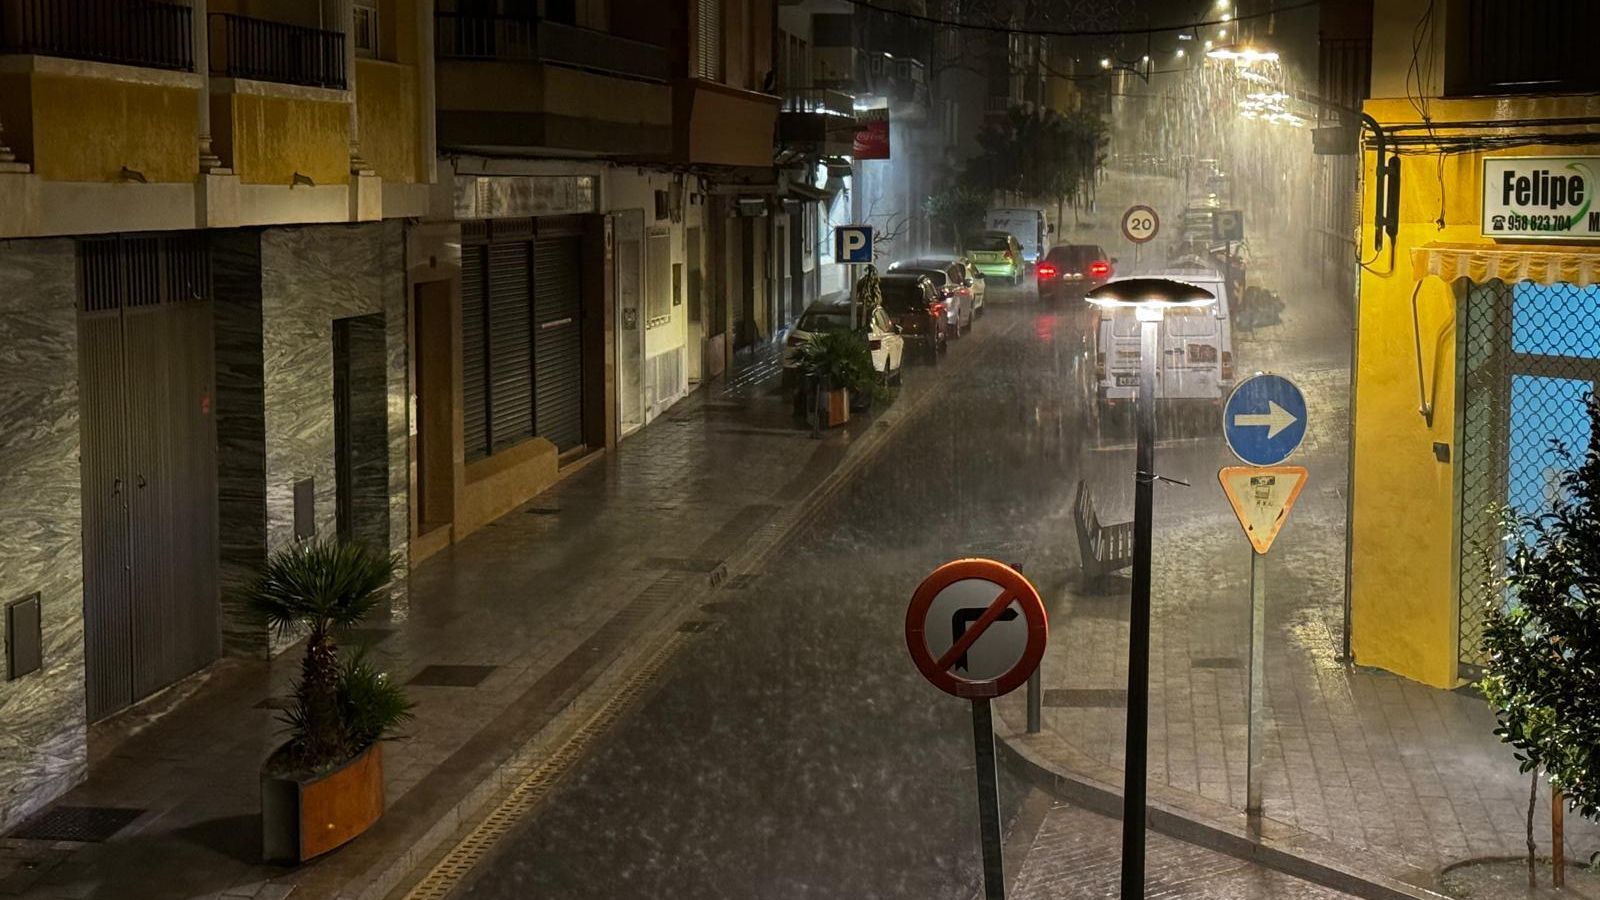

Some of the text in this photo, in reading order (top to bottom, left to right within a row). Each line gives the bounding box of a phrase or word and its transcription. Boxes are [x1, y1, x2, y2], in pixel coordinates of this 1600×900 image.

[1503, 170, 1584, 209] Felipe
[1131, 218, 1152, 230] 20
[1218, 214, 1236, 237] P
[1508, 215, 1528, 231] 958
[843, 230, 865, 259] P
